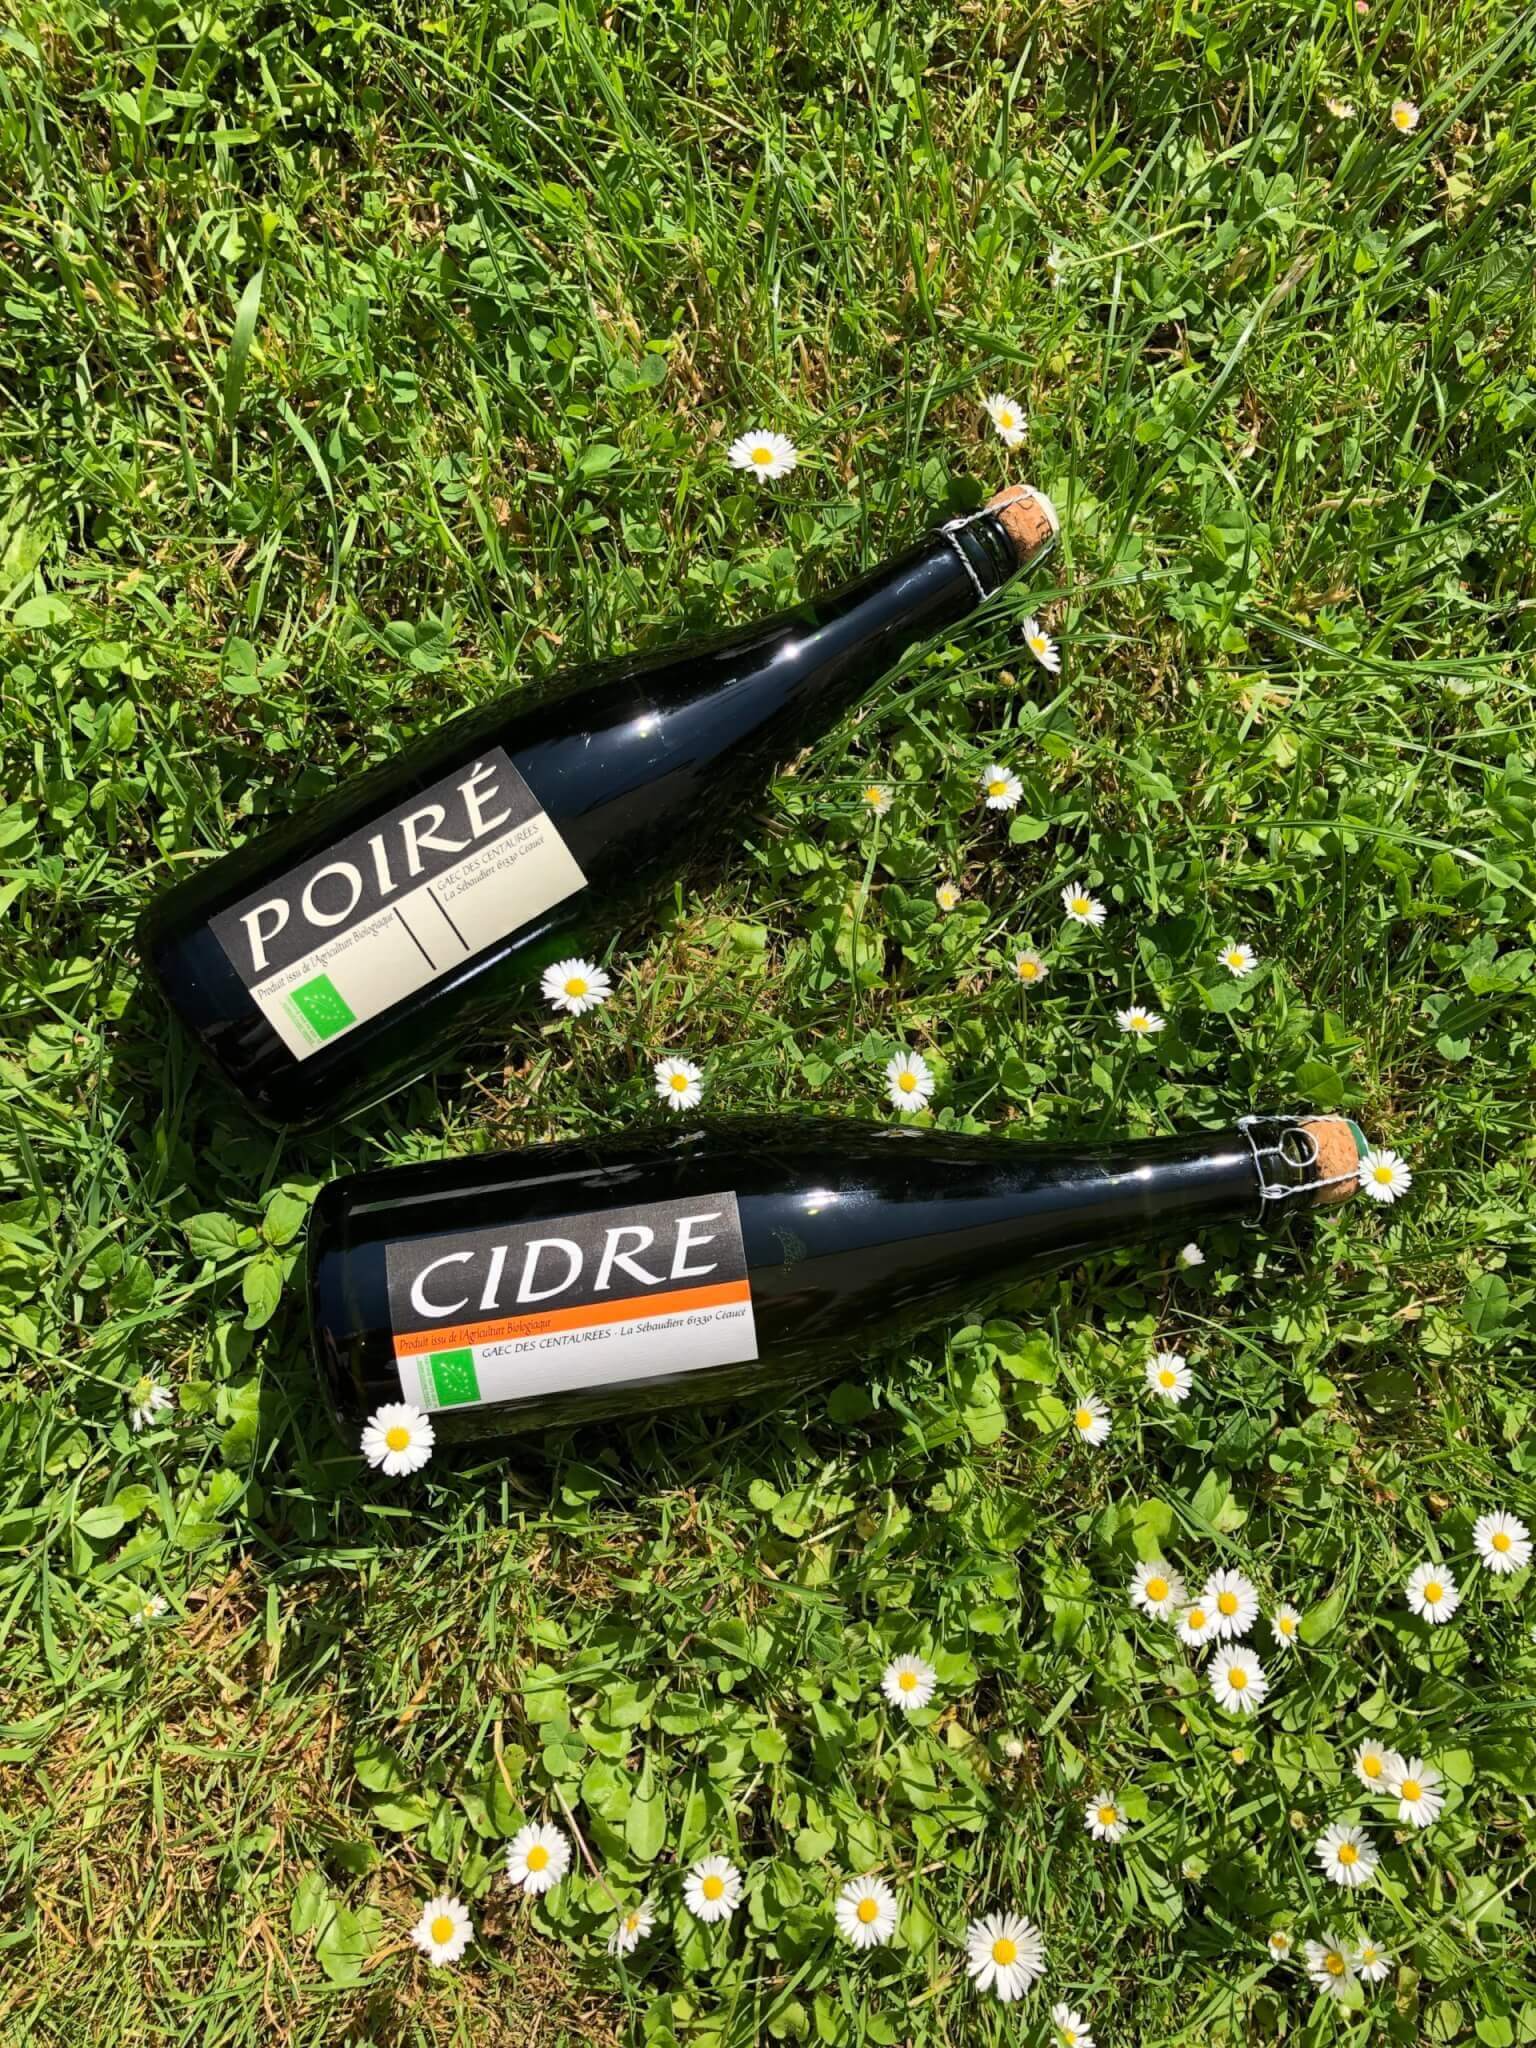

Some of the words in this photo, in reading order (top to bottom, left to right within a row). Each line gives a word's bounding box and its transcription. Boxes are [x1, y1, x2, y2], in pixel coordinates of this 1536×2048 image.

[240, 762, 512, 972] POIRÉ
[437, 870, 461, 891] GAEC
[462, 860, 481, 876] DES
[443, 889, 456, 902] La
[257, 978, 286, 1000] Produit
[287, 970, 302, 984] issu
[302, 960, 311, 974] de
[410, 1212, 722, 1318] CIDRE
[400, 1338, 429, 1350] Produit
[431, 1335, 447, 1345] issu
[449, 1332, 457, 1343] de
[506, 1319, 551, 1336] Biologique
[482, 1345, 512, 1358] GAEC
[514, 1340, 536, 1353] DES
[539, 1328, 611, 1349] CENTAURÉES
[620, 1326, 633, 1336] La
[687, 1314, 713, 1326] 61330
